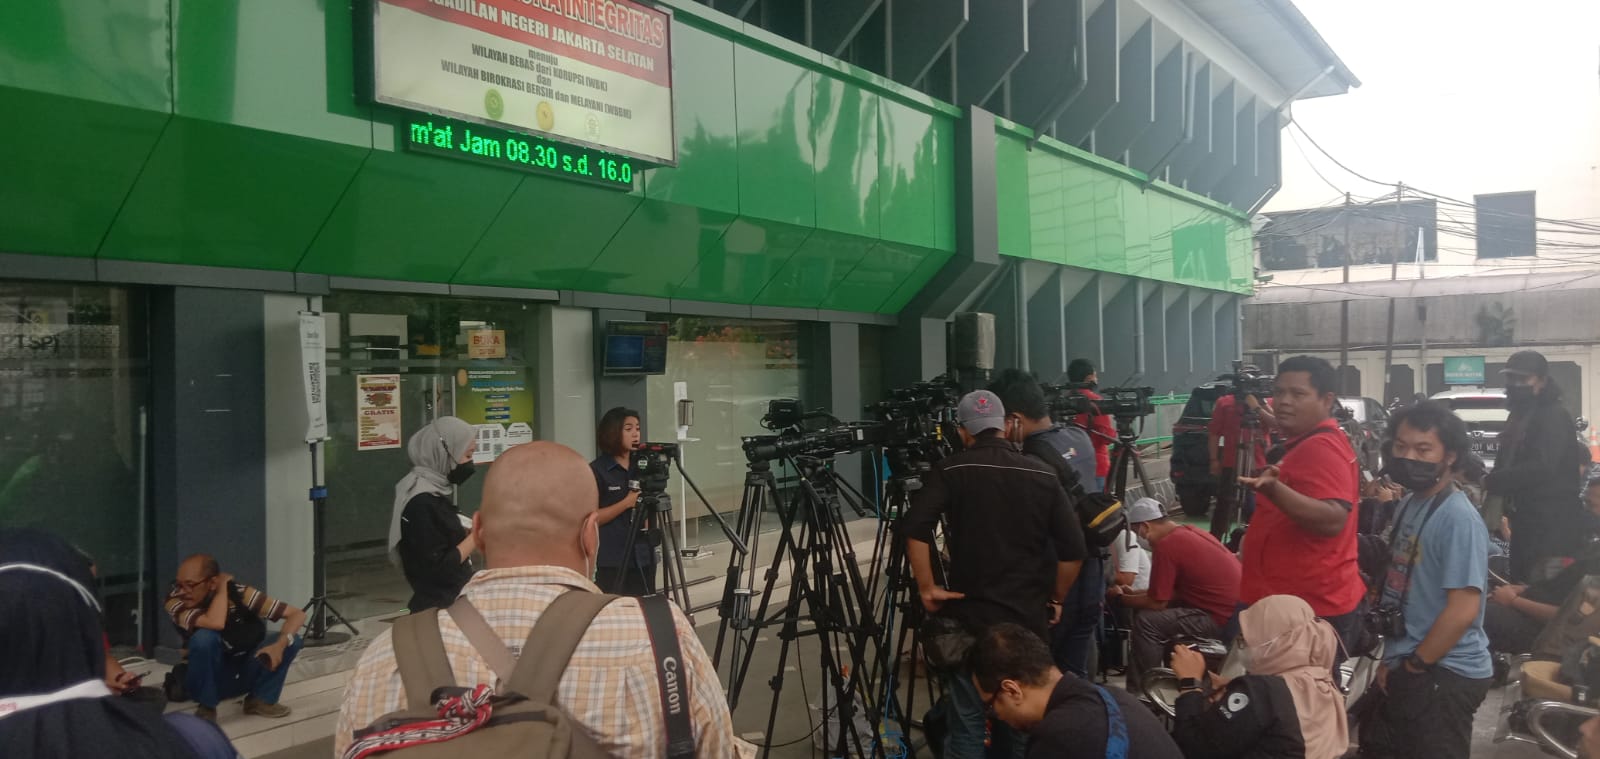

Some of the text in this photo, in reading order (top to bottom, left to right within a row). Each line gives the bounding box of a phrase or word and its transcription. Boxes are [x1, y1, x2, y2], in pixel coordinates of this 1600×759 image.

[501, 9, 550, 39] NEGERI
[552, 26, 606, 57] JAKARTA
[607, 44, 655, 72] SELATAN
[563, 0, 665, 49] INTEGRITAS
[471, 43, 508, 64] WILAYAH
[509, 54, 535, 72] BEBAS
[536, 62, 552, 76] dari
[553, 68, 585, 86] KORUPSI
[528, 49, 559, 66] menuju
[536, 74, 552, 87] dan
[441, 59, 479, 80] WILAYAH
[480, 70, 525, 92] BIROKRASI
[526, 81, 554, 100] BERSIH
[555, 90, 570, 104] dan
[570, 94, 604, 113] MELAYANI
[411, 122, 632, 184] m'at Jam 08.30 s.d. 16.0
[473, 335, 501, 345] BUKA
[663, 656, 681, 715] Canon
